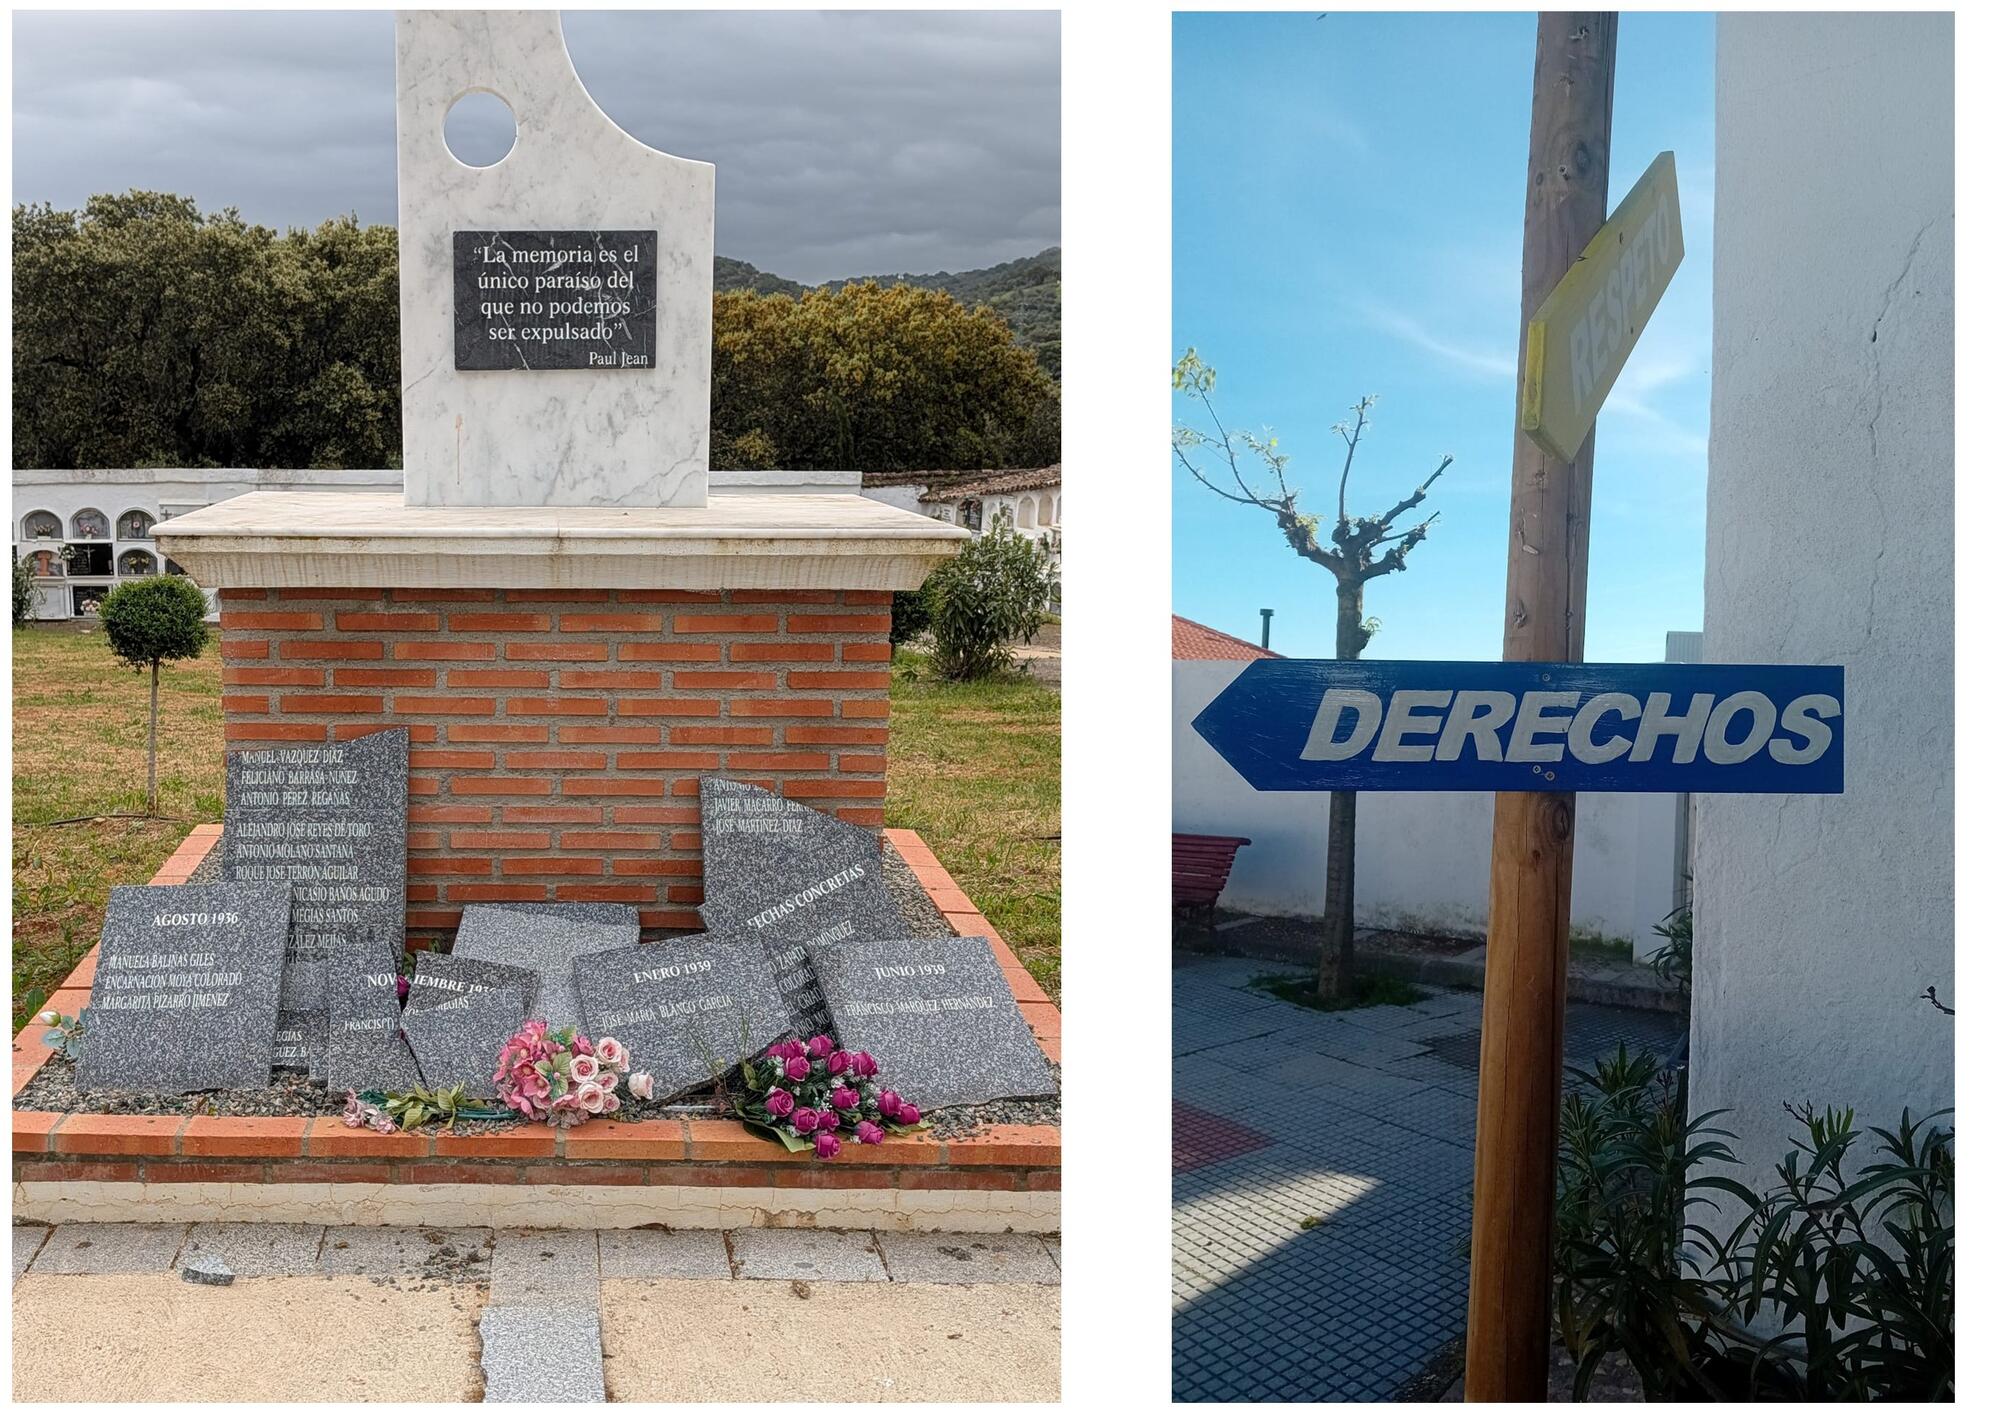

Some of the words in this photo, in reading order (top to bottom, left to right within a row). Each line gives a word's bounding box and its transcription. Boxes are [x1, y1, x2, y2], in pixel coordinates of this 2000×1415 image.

[512, 247, 592, 263] memoria
[599, 251, 617, 263] es
[624, 246, 638, 263] el
[478, 272, 528, 289] único
[535, 272, 601, 293] paraíso
[607, 271, 633, 289] del
[481, 302, 514, 319] que
[520, 302, 543, 315] no
[549, 297, 631, 319] podemos
[1569, 194, 1669, 416] RESPETO
[489, 327, 515, 340] ser
[589, 352, 616, 365] Paul
[620, 352, 649, 368] Jean
[1299, 690, 1842, 765] DERECHOS
[241, 770, 285, 785] FELICIANO
[288, 770, 325, 785] BARRASA
[241, 792, 279, 805] ANTONIO
[714, 798, 740, 814] JAVIER
[743, 798, 783, 812] MACARRO
[237, 823, 285, 838] ALEJANDRO
[307, 823, 332, 837] REYES
[335, 823, 346, 837] DE
[347, 823, 371, 837] TORO
[236, 844, 275, 858] ANTONIO
[315, 844, 354, 858] SANTANA
[236, 866, 264, 880] ROQUE
[322, 865, 358, 880] AGUILAR
[794, 863, 865, 907] CONCRETAS
[359, 887, 389, 901] AGUDO
[152, 913, 207, 927] AGOSTO
[211, 912, 238, 924] 1936
[326, 909, 359, 923] SANTOS
[109, 955, 149, 969] MANUELA
[190, 953, 215, 966] GILES
[777, 945, 808, 970] ZAPATA
[169, 973, 192, 987] MOYA
[194, 972, 242, 986] COLORADO
[634, 966, 680, 984] ENERO
[684, 960, 711, 975] 1939
[779, 966, 816, 993] COLORAD
[873, 966, 915, 980] JUNIO
[918, 964, 945, 976] 1939
[101, 995, 151, 1010] MARGARITA
[153, 993, 191, 1008] PIZARRO
[798, 987, 822, 1009] CRIAD
[659, 1002, 696, 1018] BLANCO
[845, 1002, 894, 1017] FRANCISCO
